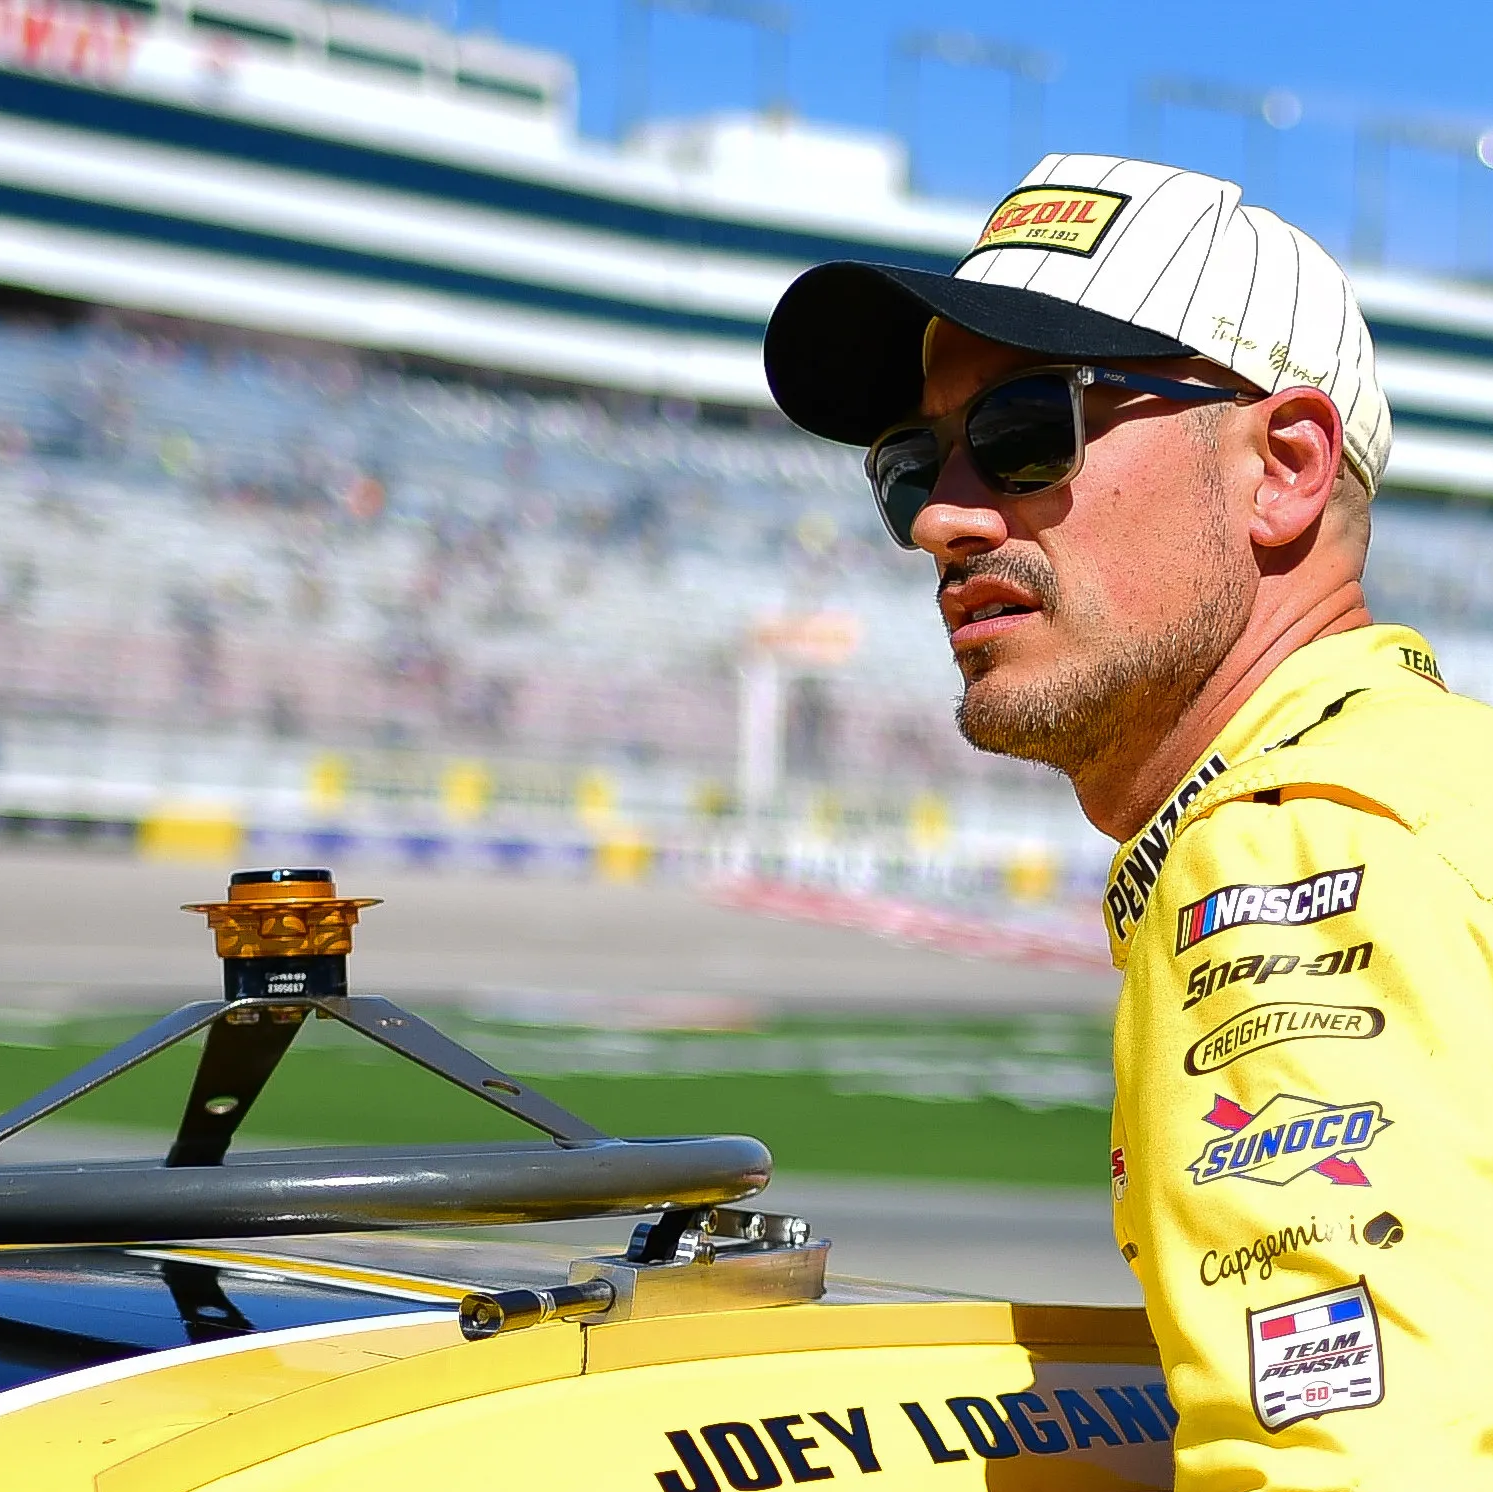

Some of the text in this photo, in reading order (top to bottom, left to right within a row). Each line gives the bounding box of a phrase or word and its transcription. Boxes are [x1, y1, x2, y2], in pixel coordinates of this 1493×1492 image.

[1212, 870, 1359, 927] NASCAR
[1181, 941, 1374, 1011] Snap-on
[1201, 1010, 1363, 1066] FREIGHTLINER
[1202, 1109, 1375, 1178] SUNOCO
[1259, 1350, 1373, 1382] PENSKE
[1283, 1330, 1361, 1361] TEAM
[1304, 1385, 1329, 1403] 60
[899, 1383, 1180, 1465] LOGAN
